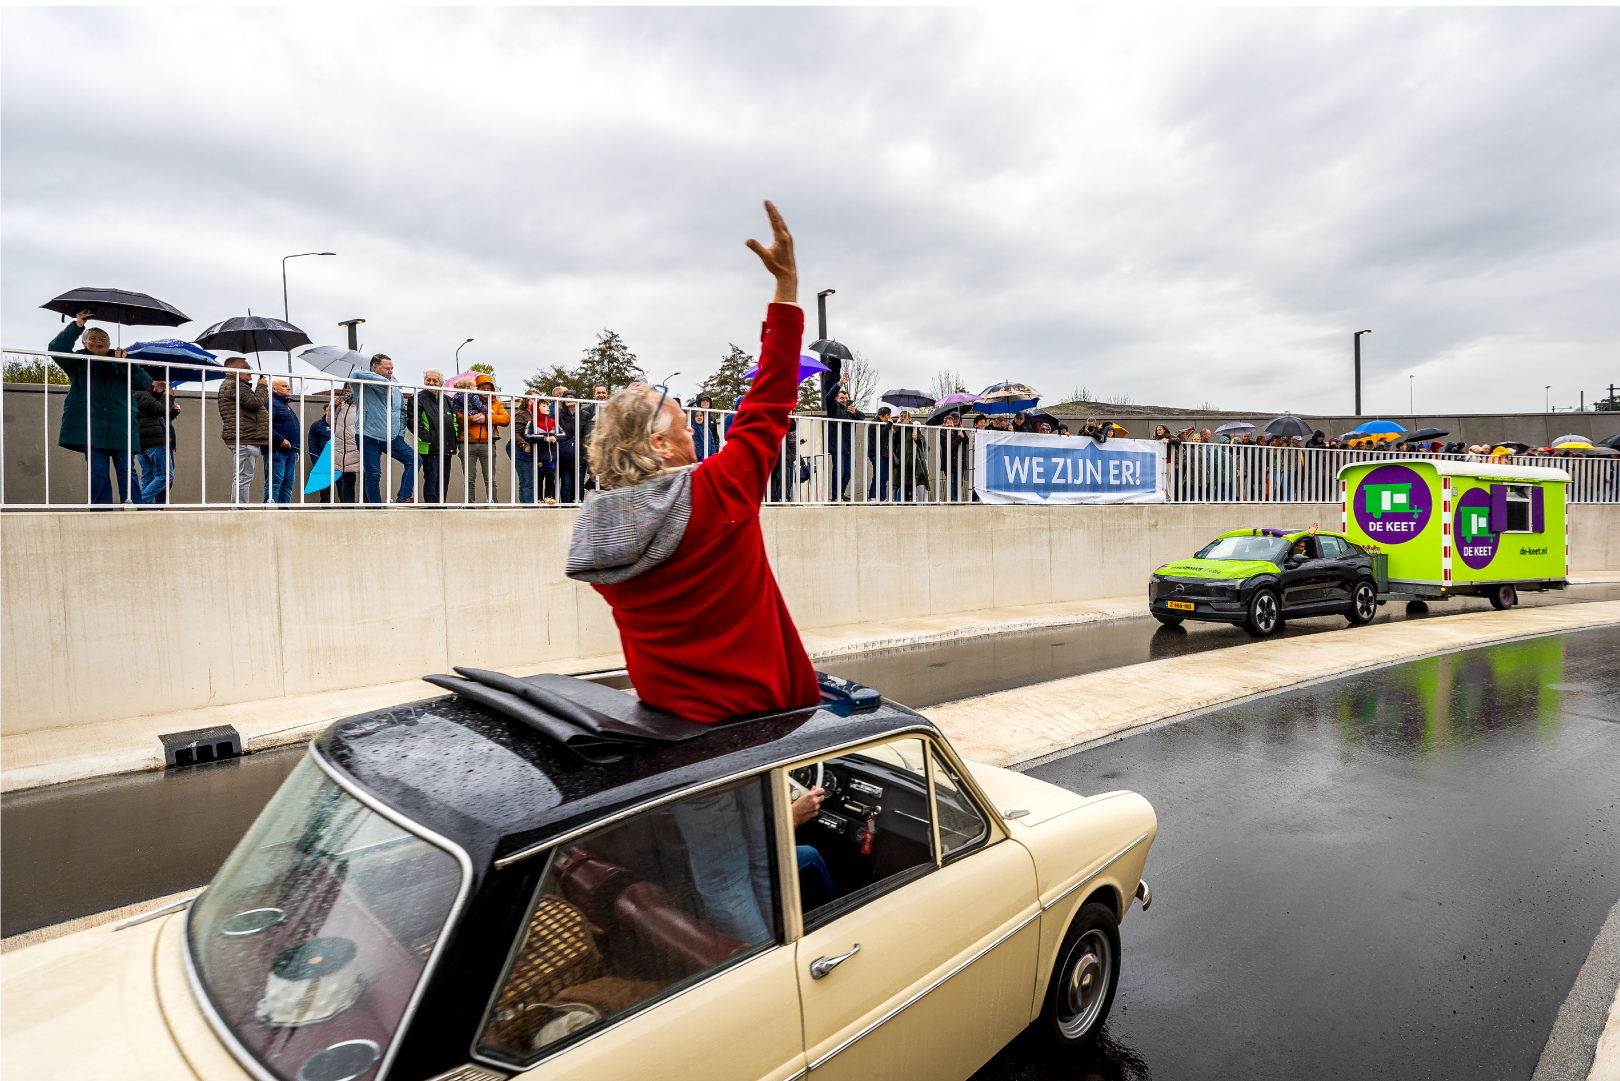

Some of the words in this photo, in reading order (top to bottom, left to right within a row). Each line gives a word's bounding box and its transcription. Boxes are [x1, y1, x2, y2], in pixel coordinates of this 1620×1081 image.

[1004, 456, 1045, 484] WE
[1052, 458, 1101, 484] ZIJN
[1109, 460, 1140, 486] ER!
[1369, 522, 1383, 531] DE
[1386, 522, 1416, 531] KEET
[1464, 546, 1473, 556] DE
[1474, 546, 1492, 556] KEET
[1520, 547, 1548, 556] de-keet.nl
